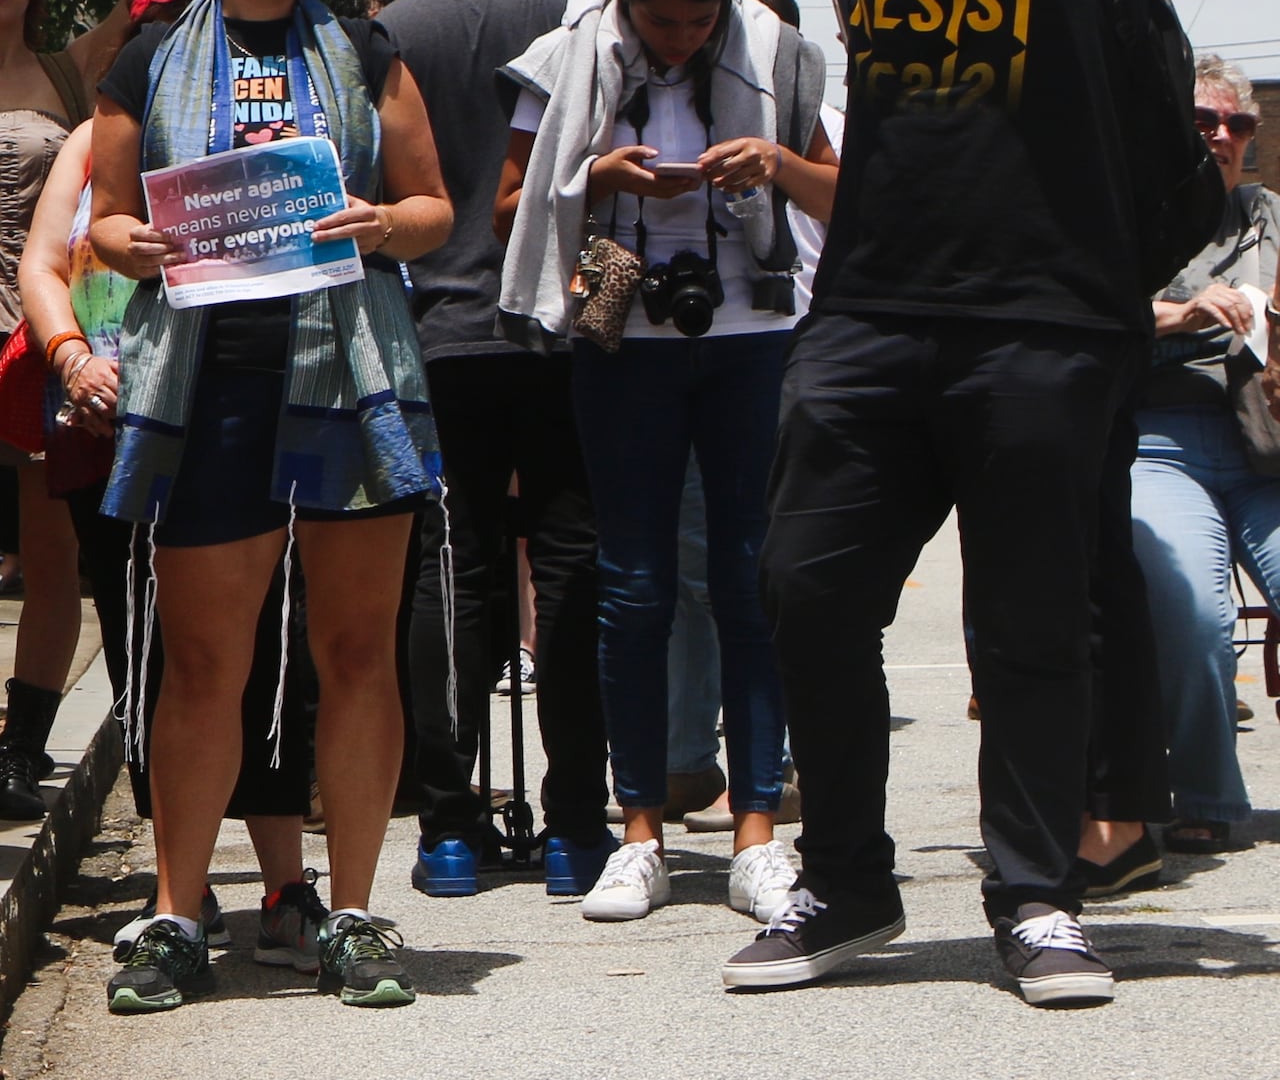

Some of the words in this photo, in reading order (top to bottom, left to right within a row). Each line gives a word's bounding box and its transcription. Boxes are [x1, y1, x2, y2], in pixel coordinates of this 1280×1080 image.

[231, 55, 287, 80] FAM
[234, 77, 284, 100] CEN
[184, 187, 243, 212] Never
[247, 172, 304, 200] again
[162, 217, 223, 238] means
[226, 202, 278, 226] never
[284, 190, 338, 216] again
[189, 237, 219, 257] for
